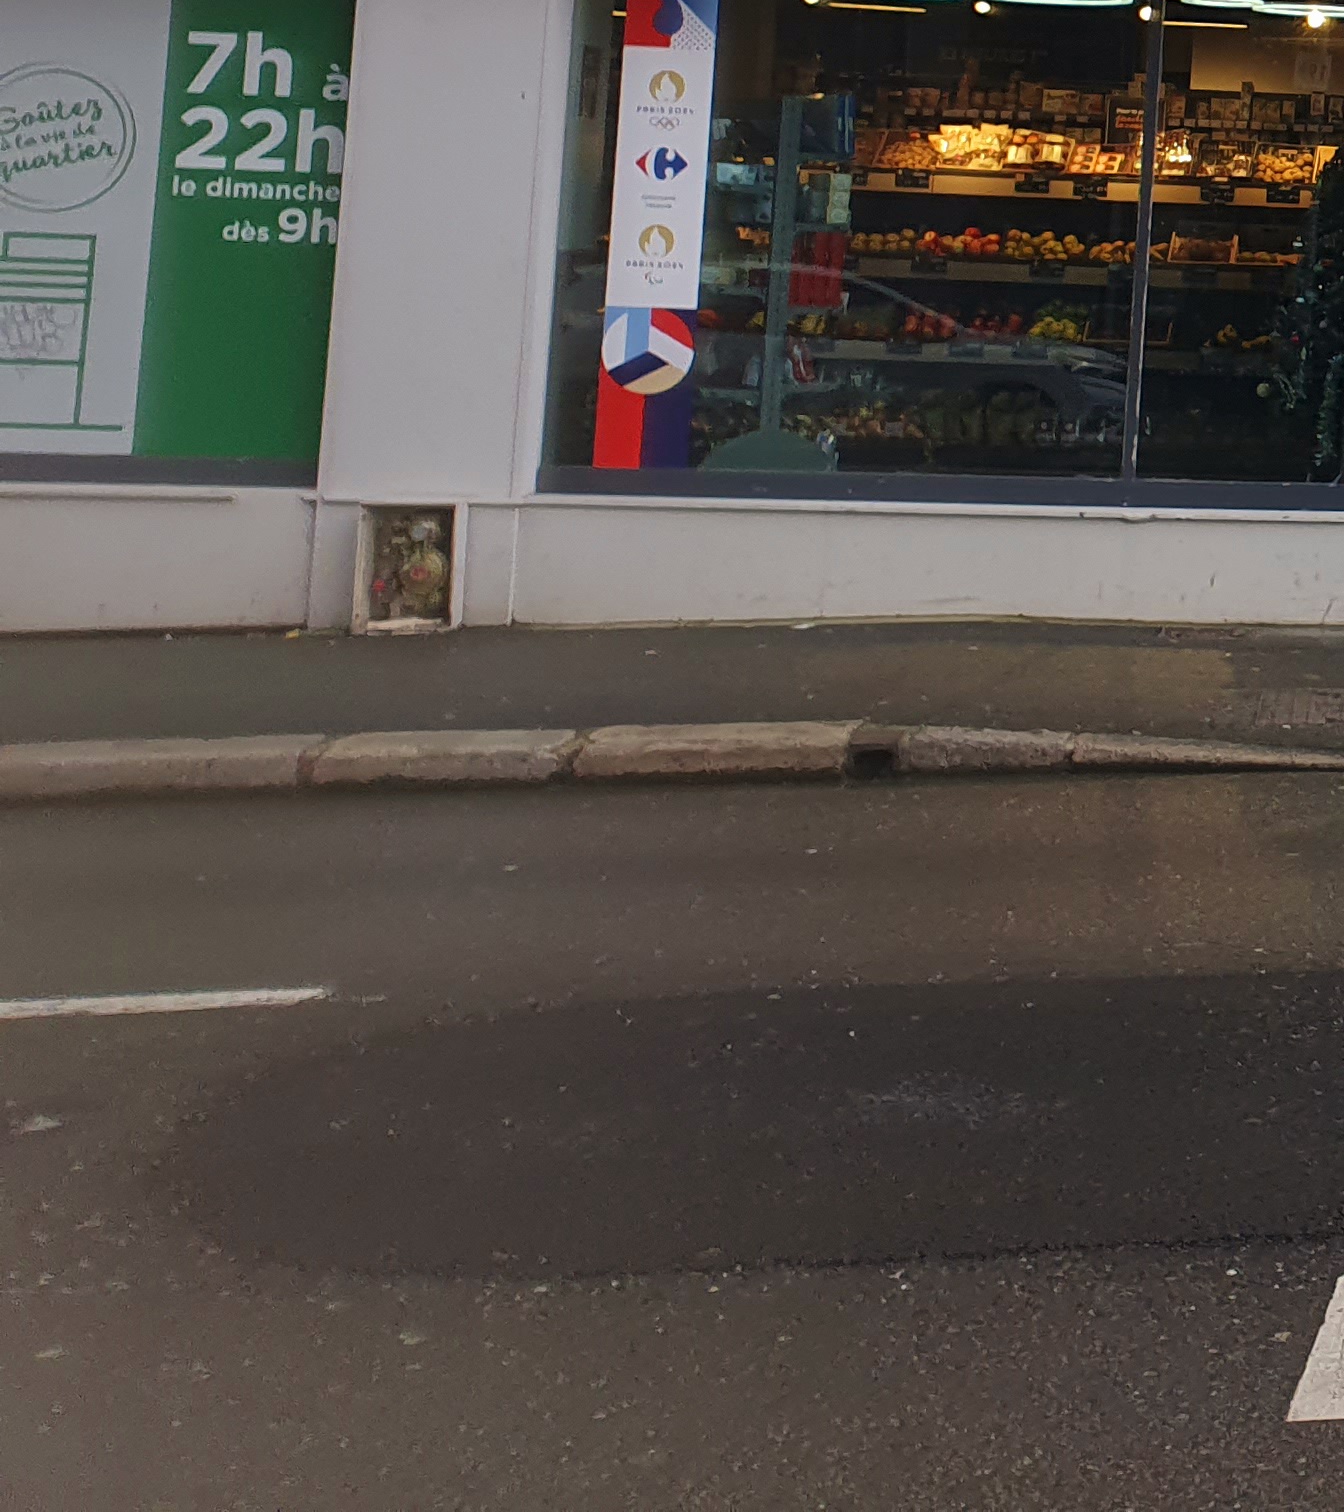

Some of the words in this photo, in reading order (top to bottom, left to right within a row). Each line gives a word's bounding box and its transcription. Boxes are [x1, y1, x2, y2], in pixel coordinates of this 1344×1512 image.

[186, 30, 293, 97] 7h
[322, 63, 349, 101] à
[175, 105, 344, 174] 22h
[172, 175, 196, 197] le
[206, 176, 341, 202] dimanche
[222, 218, 270, 242] dès
[278, 207, 338, 245] 9h
